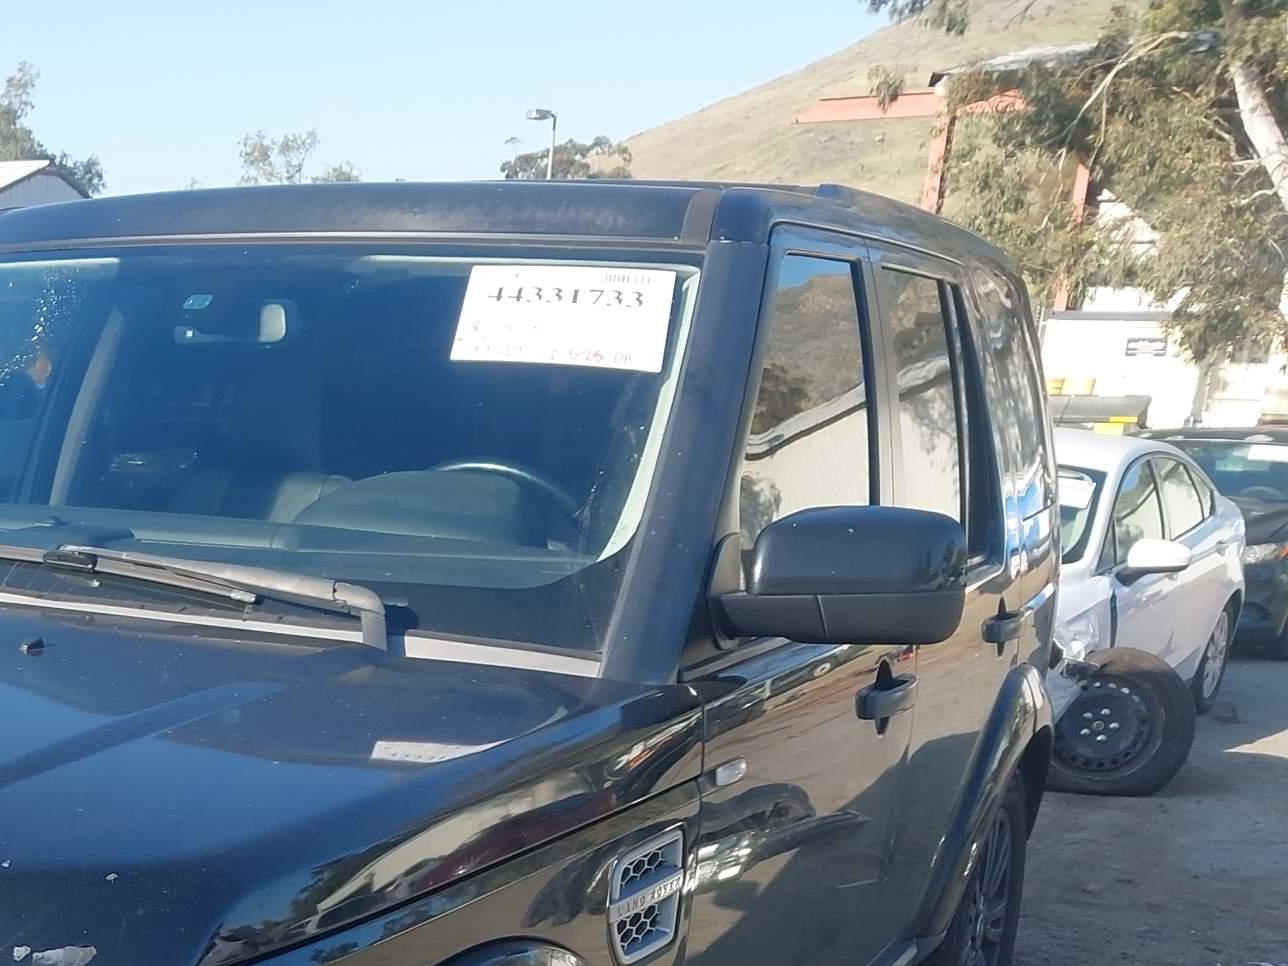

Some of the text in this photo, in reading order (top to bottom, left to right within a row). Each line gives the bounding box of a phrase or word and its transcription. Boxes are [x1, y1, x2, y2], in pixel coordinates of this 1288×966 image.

[487, 286, 645, 309] 44331733
[616, 876, 681, 918] LAND ROVER
